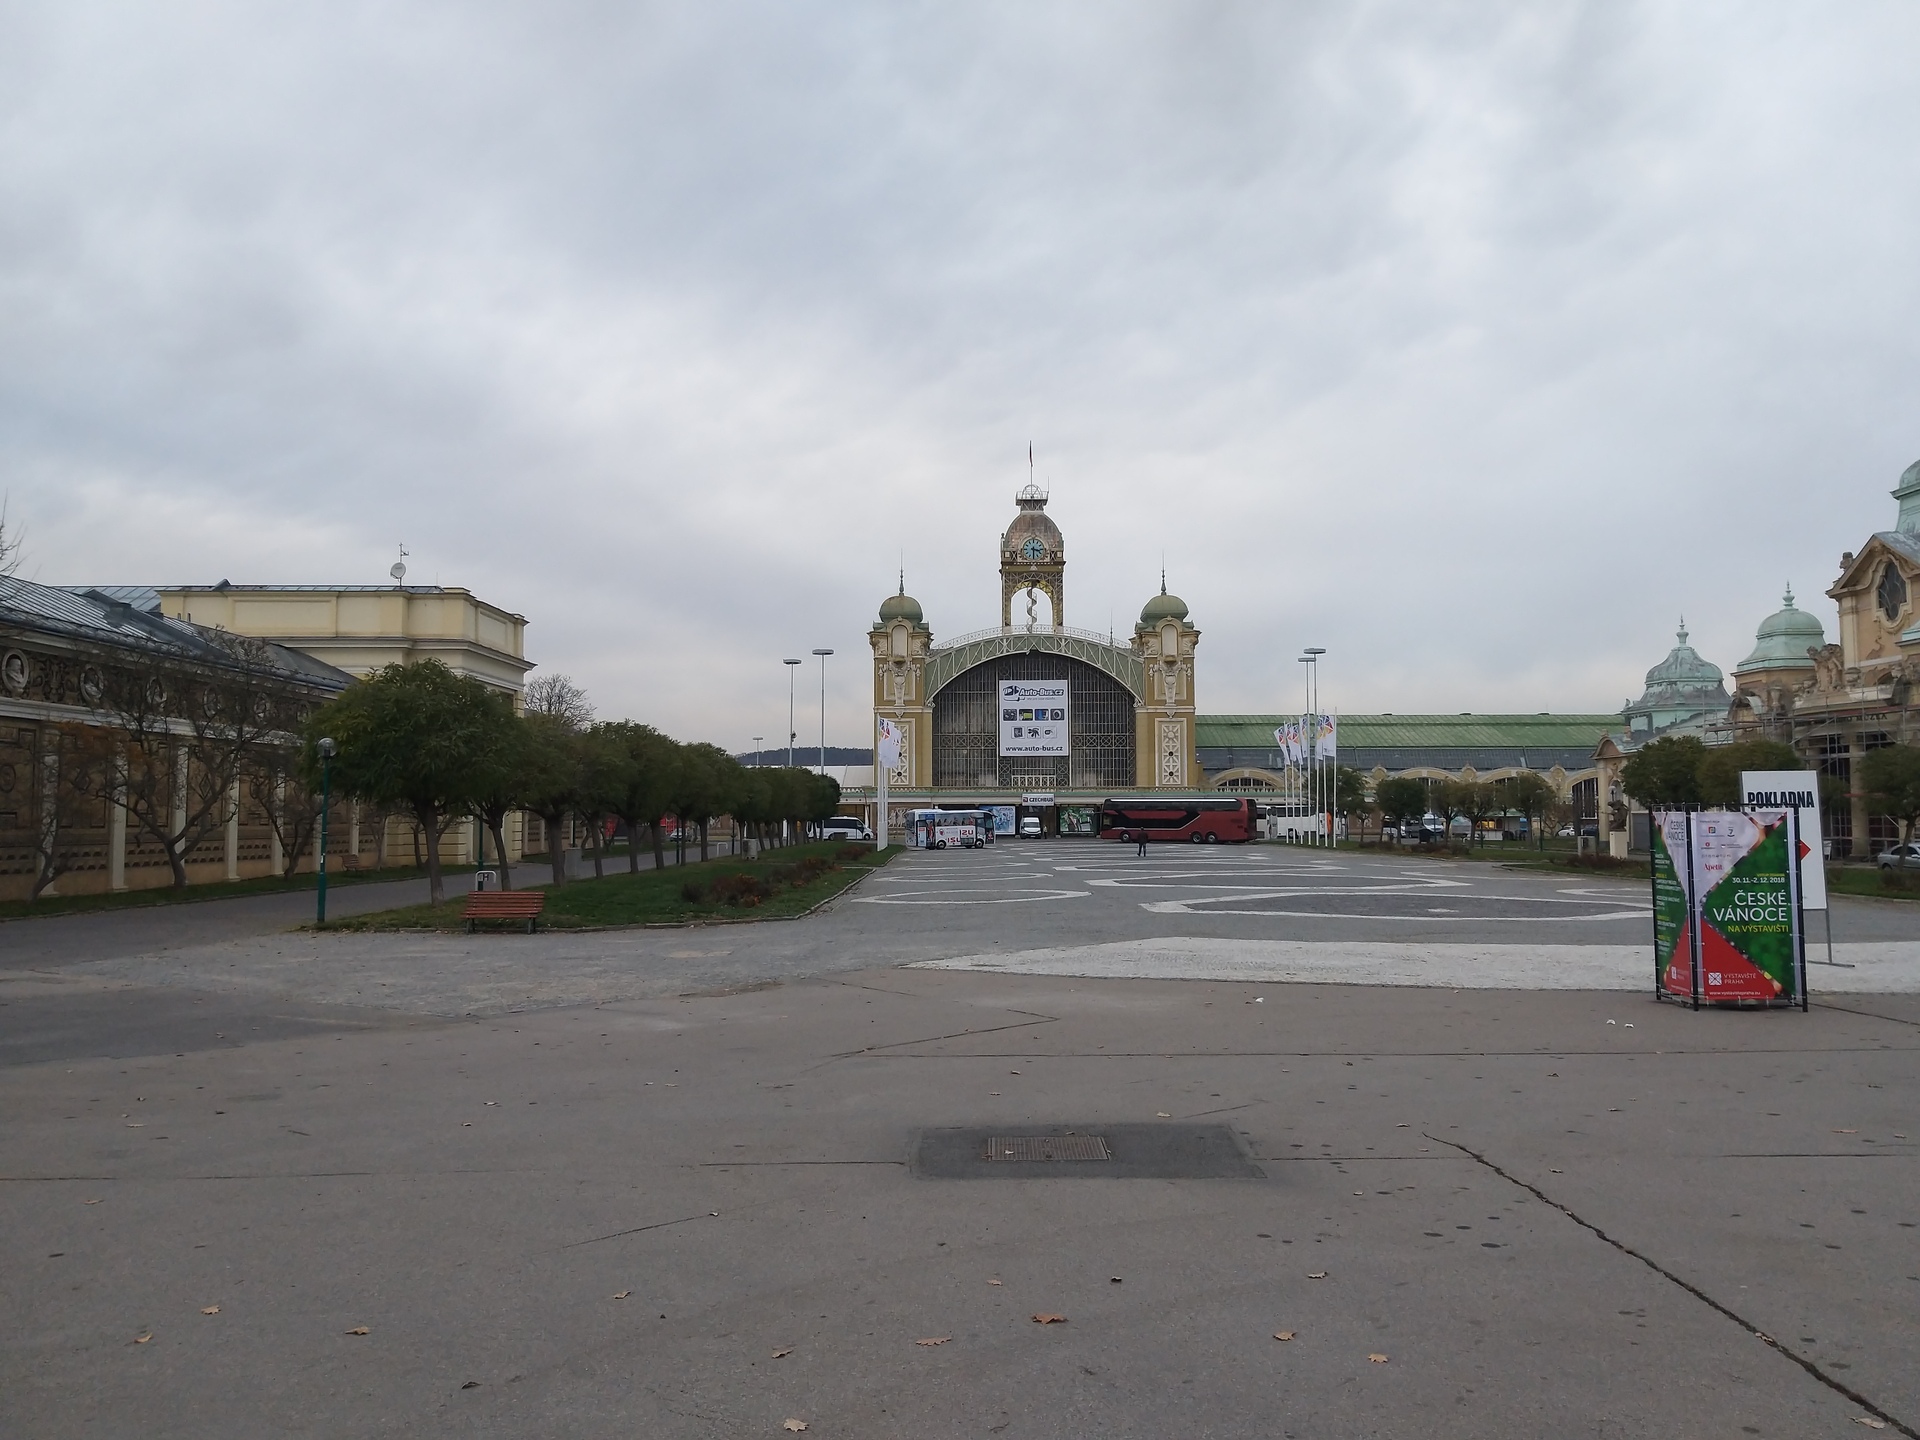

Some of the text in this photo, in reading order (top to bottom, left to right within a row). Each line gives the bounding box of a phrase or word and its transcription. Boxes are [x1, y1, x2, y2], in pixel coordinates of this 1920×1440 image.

[1020, 688, 1064, 696] Auto-Bus.cz
[1747, 791, 1815, 809] POKLADNA
[1704, 863, 1723, 871] Apetit
[1734, 889, 1787, 905] ČESKÉ
[1713, 905, 1788, 921] VÁNOCE
[1742, 924, 1789, 932] VÝSTAVIŠTI
